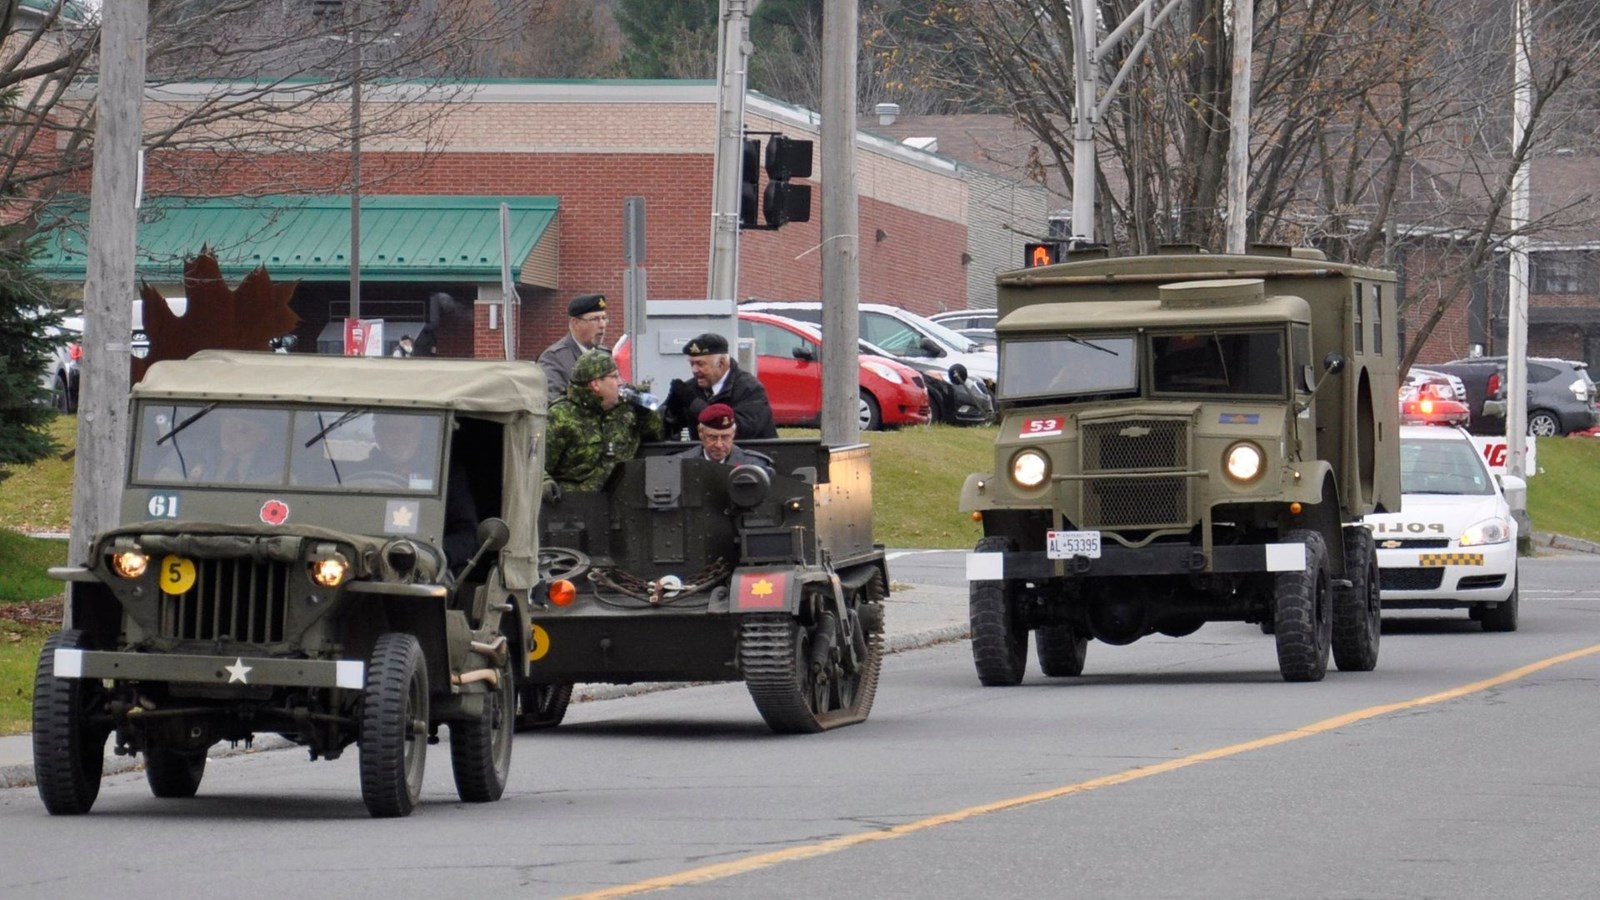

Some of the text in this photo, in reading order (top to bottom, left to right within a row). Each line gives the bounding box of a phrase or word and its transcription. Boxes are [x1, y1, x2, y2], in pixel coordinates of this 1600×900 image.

[1030, 419, 1057, 432] 53
[1483, 444, 1528, 467] IG
[148, 495, 177, 517] 61
[169, 562, 182, 583] 5
